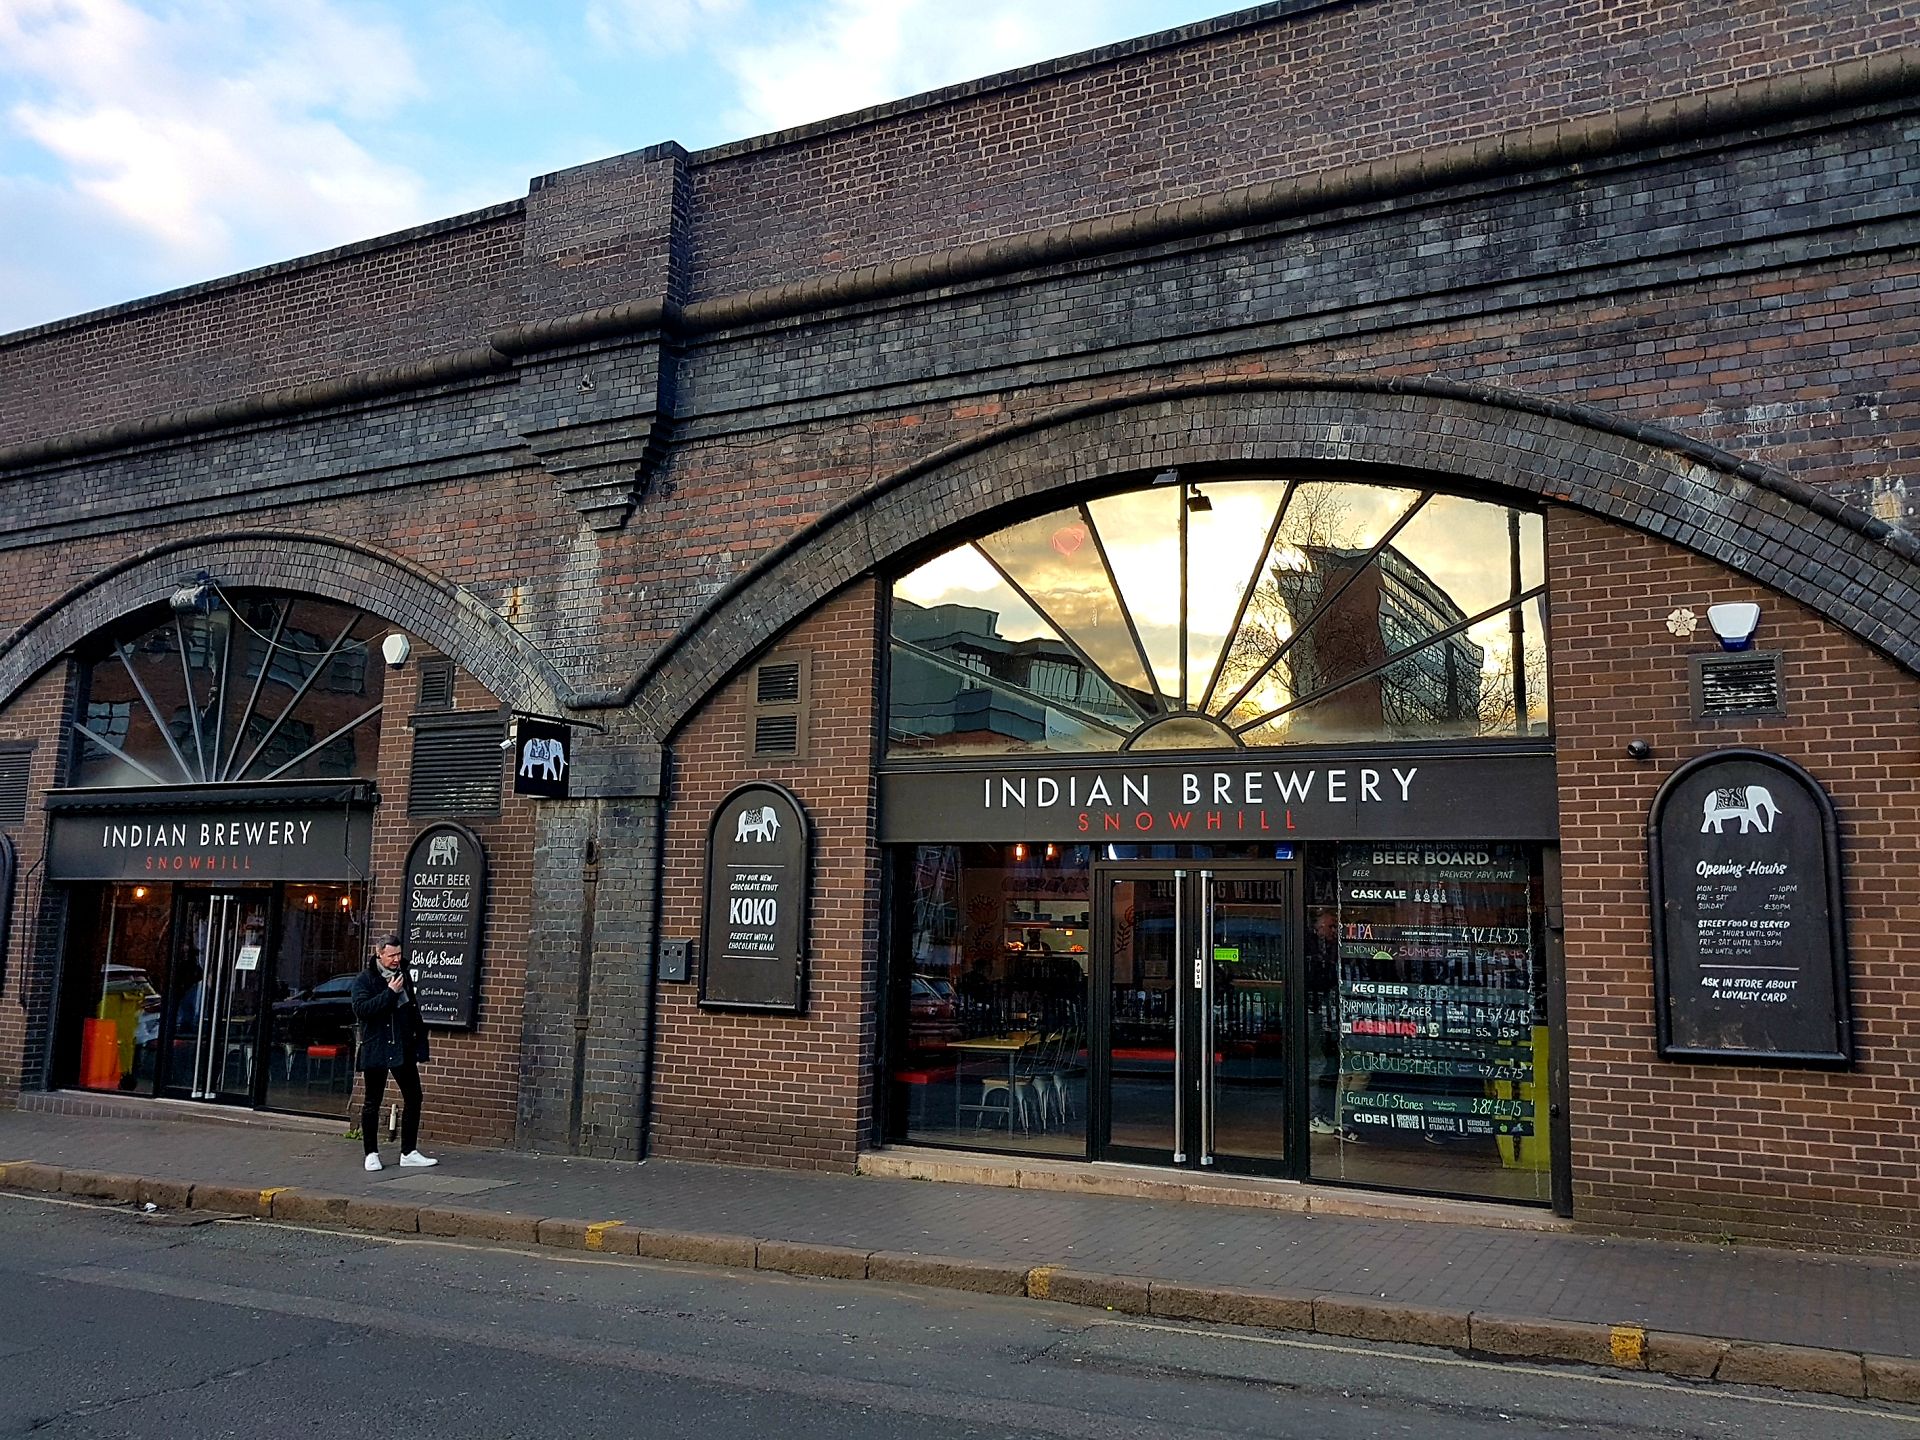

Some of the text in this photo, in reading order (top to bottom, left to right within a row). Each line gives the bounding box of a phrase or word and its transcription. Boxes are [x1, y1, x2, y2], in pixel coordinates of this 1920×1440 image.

[985, 768, 1418, 808] INDIAN BREWERY
[1078, 810, 1296, 831] SNOWHILL
[103, 821, 312, 848] INDIAN BREWERY
[145, 855, 251, 870] SNOWHILL
[1373, 852, 1489, 866] BEER BOARD
[1440, 870, 1473, 878] BREWERY
[1496, 870, 1514, 879] PINT
[1696, 859, 1787, 878] Opening Hours
[414, 873, 471, 886] CRAFT BEER
[730, 883, 779, 892] CHOCOLATE STOUT
[1351, 889, 1406, 899] CASK ALE
[412, 890, 470, 909] Street Food
[415, 912, 447, 922] AUTHENTIC
[729, 897, 777, 926] KOKO
[1697, 920, 1790, 929] STREET FOOD IS SERVED
[730, 932, 774, 942] PERFECT WITH A
[1347, 924, 1373, 940] IPA
[728, 942, 775, 951] CHOCOLATE NAAN
[1399, 946, 1443, 957] SUMMER
[1715, 947, 1733, 955] UNTIL
[410, 949, 464, 968] Let's Get Social
[1701, 977, 1797, 989] ASK IN STORE ABOUT
[1353, 984, 1408, 996] KEG BEER
[1712, 990, 1787, 1002] A LOYALTY CARD
[1343, 1000, 1395, 1015] BIRMINGHAM
[1399, 1004, 1432, 1017] LAGER
[1352, 1020, 1417, 1036] LAGUNITAS
[1346, 1092, 1374, 1107] Game
[1392, 1094, 1424, 1110] Stones
[1353, 1113, 1388, 1125] CIDER
